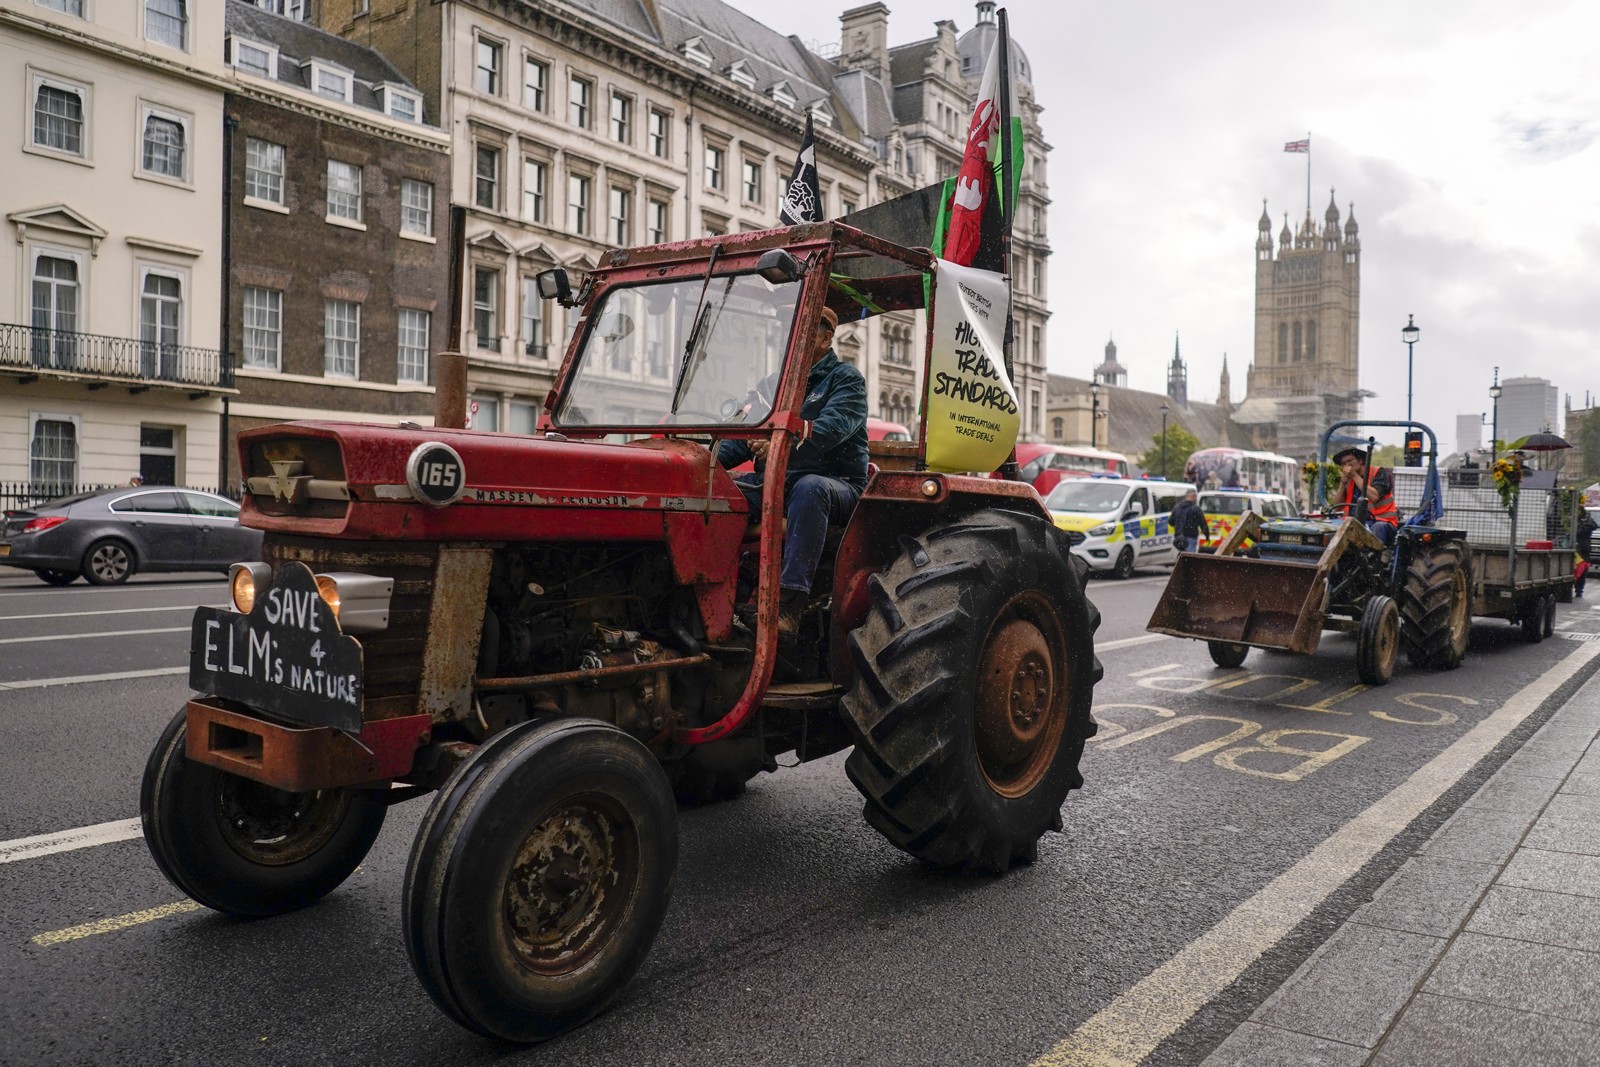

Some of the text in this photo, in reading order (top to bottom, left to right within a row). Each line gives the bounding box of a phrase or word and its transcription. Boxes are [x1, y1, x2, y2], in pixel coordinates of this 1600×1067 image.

[955, 320, 985, 351] HIG
[934, 372, 1018, 415] STANDARDS
[949, 412, 1001, 432] IN INTERNATIONAL
[955, 426, 995, 443] TRADE DEALS
[421, 462, 457, 487] 165
[476, 490, 534, 501] MASSEY
[1141, 536, 1173, 549] POLICE
[265, 587, 322, 633] SAVE
[310, 639, 327, 667] 4
[291, 664, 359, 707] NATURE
